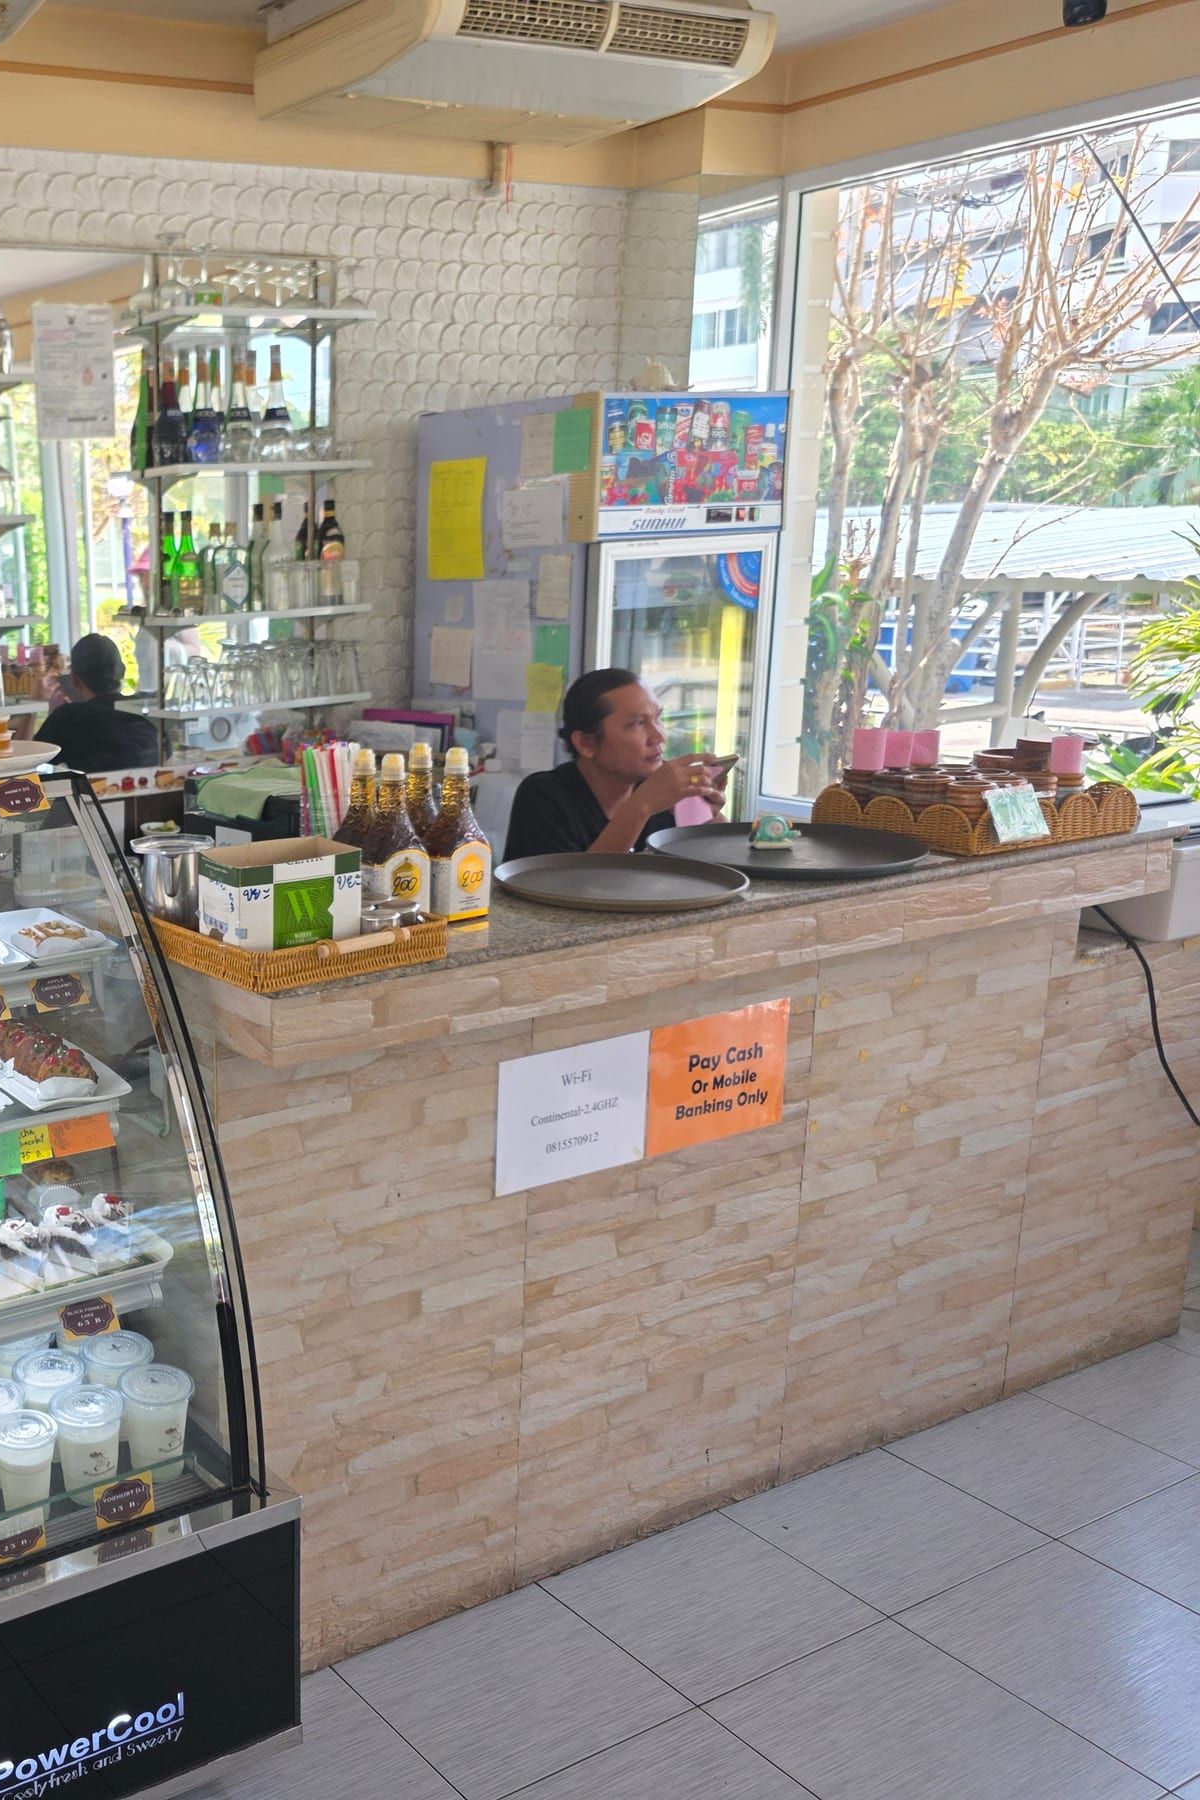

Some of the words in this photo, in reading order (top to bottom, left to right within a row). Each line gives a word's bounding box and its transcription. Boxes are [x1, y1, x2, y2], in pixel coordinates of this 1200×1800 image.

[629, 517, 686, 531] SUNHUI
[687, 1054, 722, 1073] Pay
[725, 1042, 764, 1065] Cash
[561, 1069, 593, 1088] Wi-Fi
[691, 1079, 709, 1094] Or
[712, 1070, 757, 1091] Mobile
[675, 1096, 733, 1121] Banking
[737, 1088, 768, 1107] Only
[545, 1132, 599, 1154] 0815570912
[92, 1749, 122, 1771] and
[126, 1725, 183, 1758] Sweety
